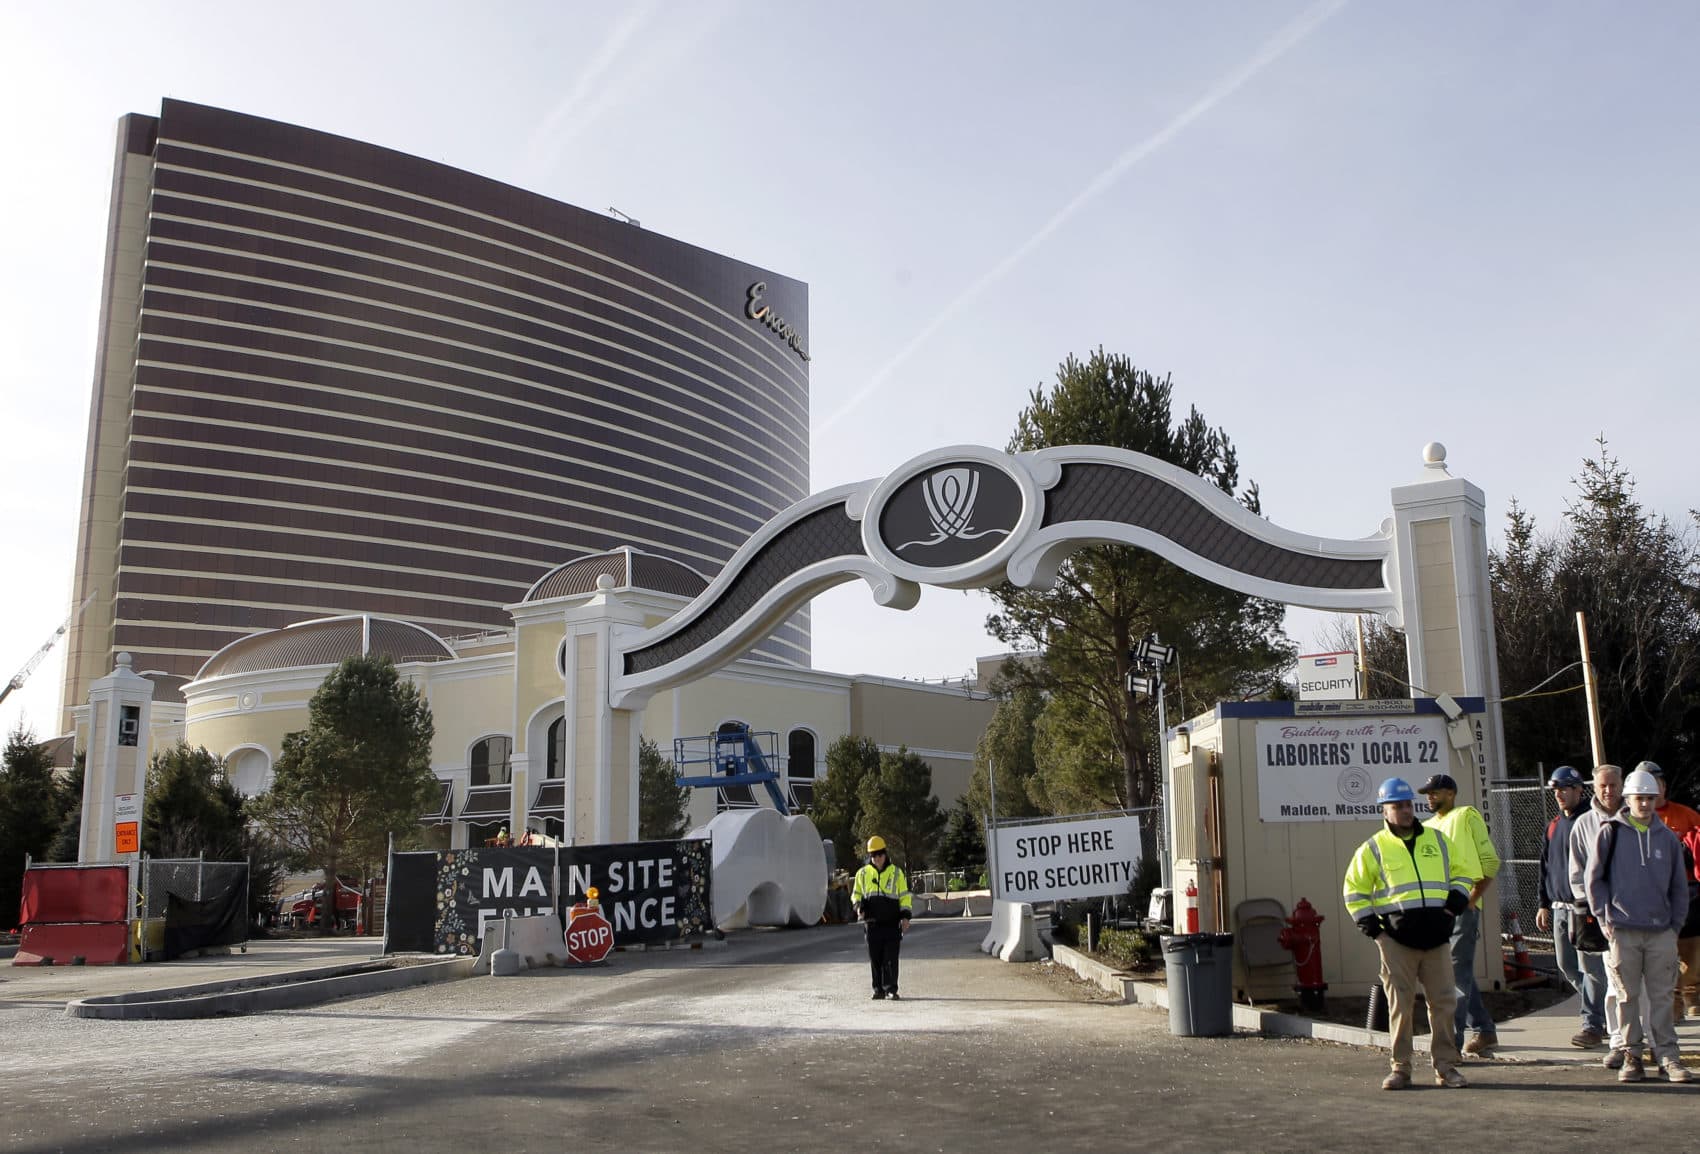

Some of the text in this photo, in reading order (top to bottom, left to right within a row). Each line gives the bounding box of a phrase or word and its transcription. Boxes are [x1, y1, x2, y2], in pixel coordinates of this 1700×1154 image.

[1301, 679, 1353, 692] SECURITY
[1280, 724, 1422, 741] Building with Pride
[1267, 740, 1438, 766] LABORERS' LOCAL 22
[1336, 803, 1430, 815] Massactts
[1016, 830, 1114, 859] STOP HERE
[608, 858, 673, 893] SITE
[1004, 861, 1131, 893] FOR SECURITY
[569, 927, 609, 950] STOP
